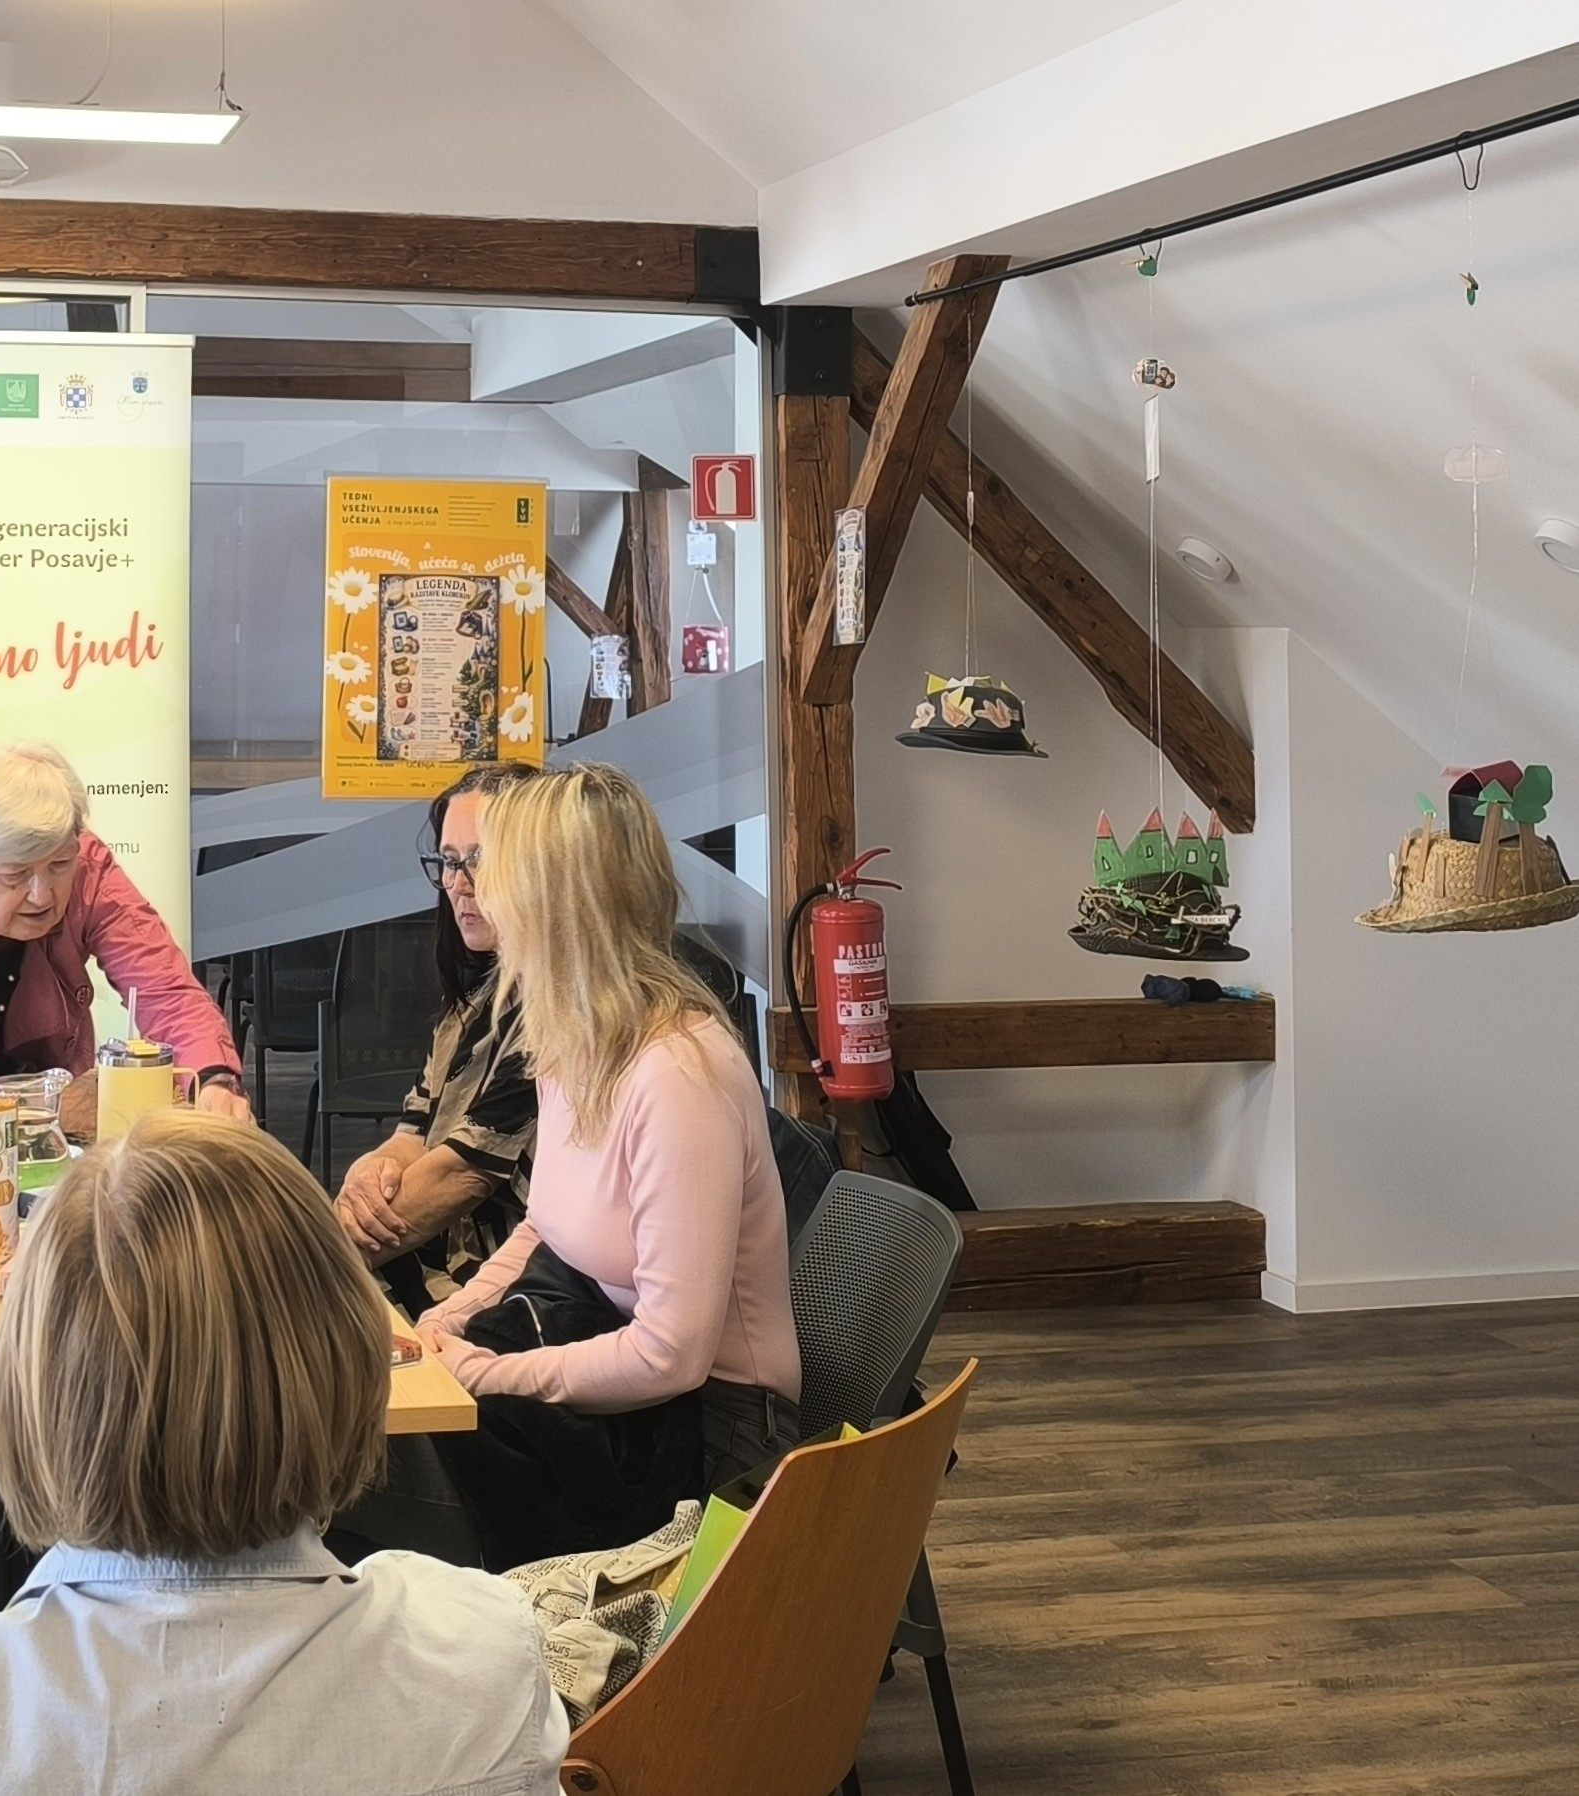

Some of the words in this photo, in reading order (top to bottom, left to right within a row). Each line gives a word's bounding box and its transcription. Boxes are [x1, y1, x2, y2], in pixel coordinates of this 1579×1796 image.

[342, 503, 439, 514] VSEŽIVLJENJSKEGA
[342, 515, 381, 525] UČENJA
[30, 548, 135, 572] Posavje+
[416, 580, 467, 591] LEGENDA
[55, 611, 164, 690] ljudi
[86, 780, 169, 798] namenjen:
